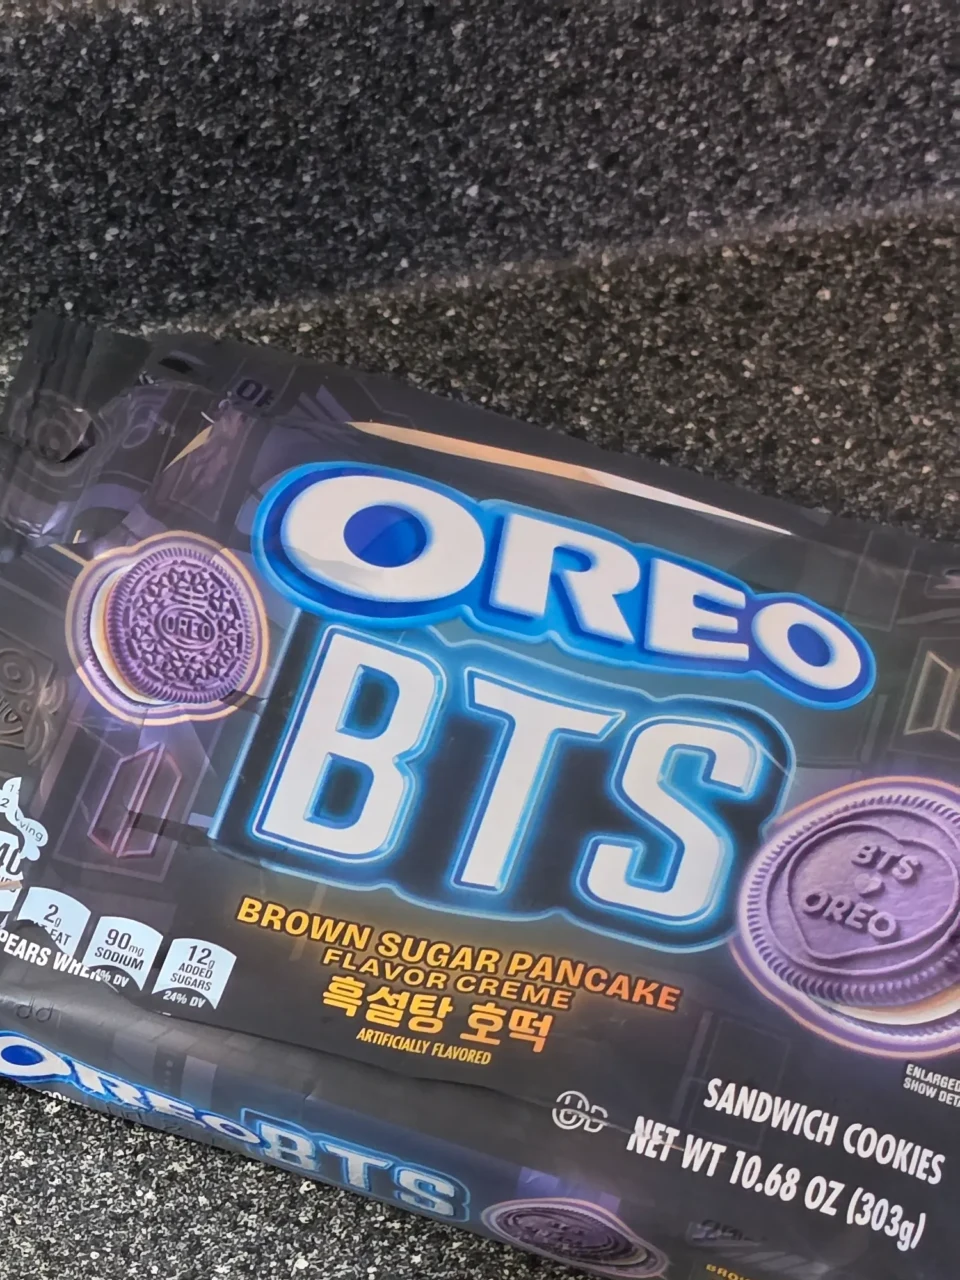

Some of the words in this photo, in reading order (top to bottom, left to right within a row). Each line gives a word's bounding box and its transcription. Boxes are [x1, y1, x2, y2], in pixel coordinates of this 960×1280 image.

[278, 473, 863, 692] OREO
[165, 612, 212, 641] OREO
[258, 628, 760, 920] BTS
[0, 797, 10, 809] 2
[849, 843, 921, 881] BTS
[802, 889, 897, 938] OREO
[94, 946, 145, 972] SODIUM
[105, 928, 145, 958] 90mg
[188, 944, 216, 971] 12g
[236, 896, 372, 952] BROWN
[377, 931, 502, 975] SUGAR
[507, 949, 682, 1011] PANCAKE
[113, 975, 130, 988] DV
[169, 972, 213, 992] SUGARS
[178, 962, 214, 980] ADDED
[322, 948, 449, 990] FLAVOR
[455, 973, 576, 1011] CREME
[162, 989, 188, 1005] 24%
[189, 996, 208, 1009] DV
[321, 974, 454, 1035] 흑설탕
[459, 1002, 555, 1054] 호떡
[355, 1026, 432, 1056] ARTIFICIALLY
[430, 1041, 492, 1066] FLAVORED
[903, 1076, 938, 1099] SHOW
[703, 1077, 839, 1147] SANDWICH
[843, 1122, 946, 1186] COOKIES
[259, 1120, 458, 1217] BTS
[625, 1115, 681, 1163] NET
[681, 1133, 728, 1178] WT
[728, 1150, 802, 1203] 10.68
[804, 1175, 845, 1216] OZ
[846, 1186, 927, 1252] (303g)
